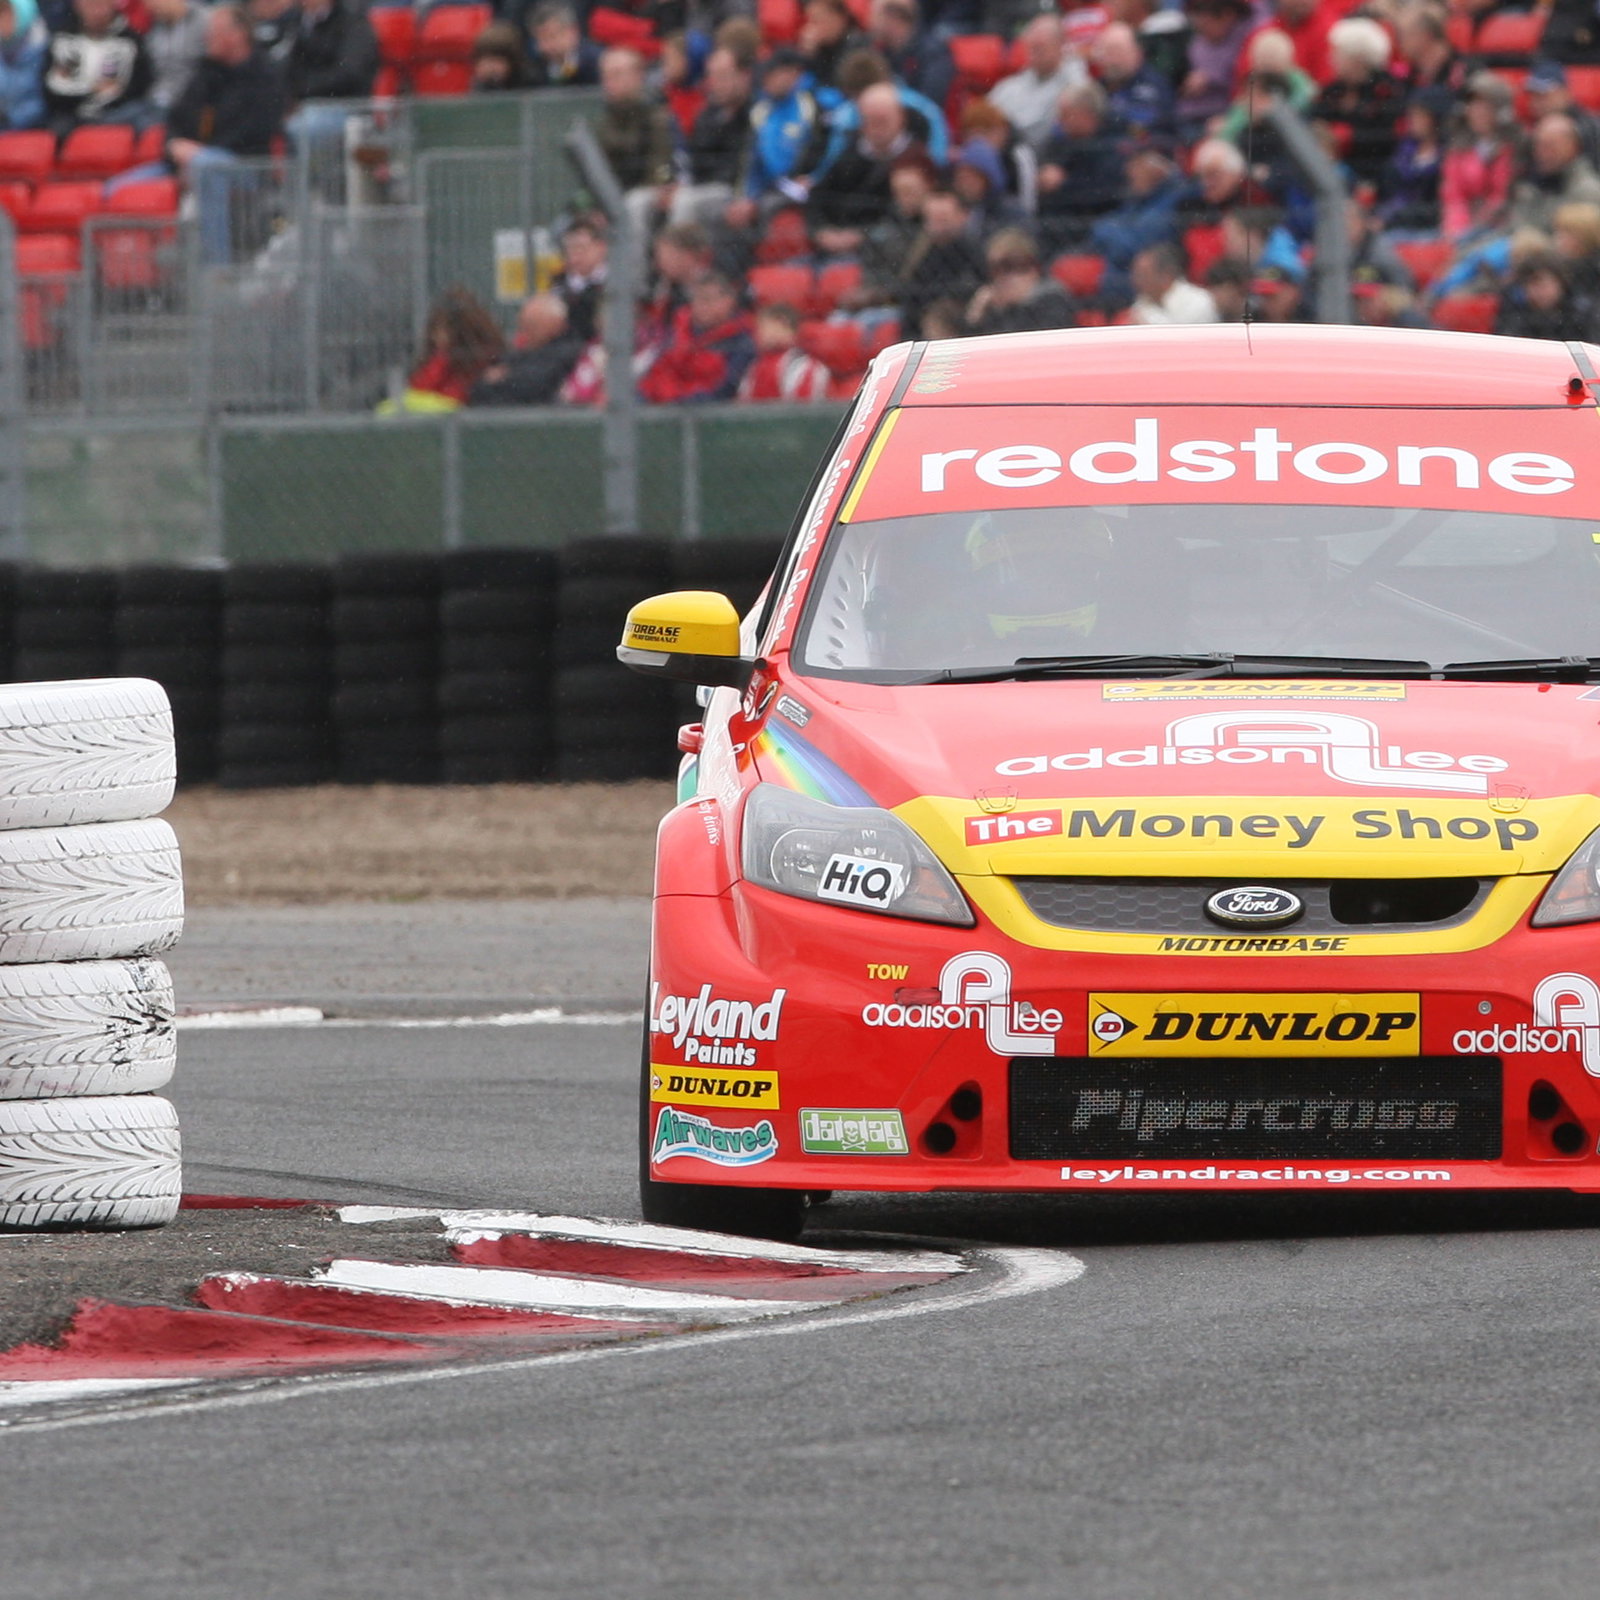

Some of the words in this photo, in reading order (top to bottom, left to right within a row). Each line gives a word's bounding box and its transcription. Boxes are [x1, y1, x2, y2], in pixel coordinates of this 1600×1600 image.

[922, 418, 1575, 495] redstone
[1155, 684, 1401, 692] DUNLOP
[995, 745, 1317, 776] addison
[1387, 745, 1509, 773] lee
[970, 816, 1053, 840] The
[1068, 809, 1325, 849] Money
[1352, 809, 1539, 850] Shop
[823, 860, 891, 901] HiQ
[1228, 892, 1280, 912] Ford
[1157, 937, 1349, 951] MOTORBASE
[866, 963, 909, 980] TOW
[650, 981, 787, 1049] Leyland
[1013, 1001, 1063, 1032] lee
[1143, 1012, 1416, 1041] DUNLOP
[684, 1037, 756, 1066] Paints
[1453, 1023, 1581, 1053] addison
[667, 1076, 772, 1097] DUNLOP
[654, 1109, 772, 1156] Airwaves
[1060, 1166, 1451, 1183] leylandracing.com
